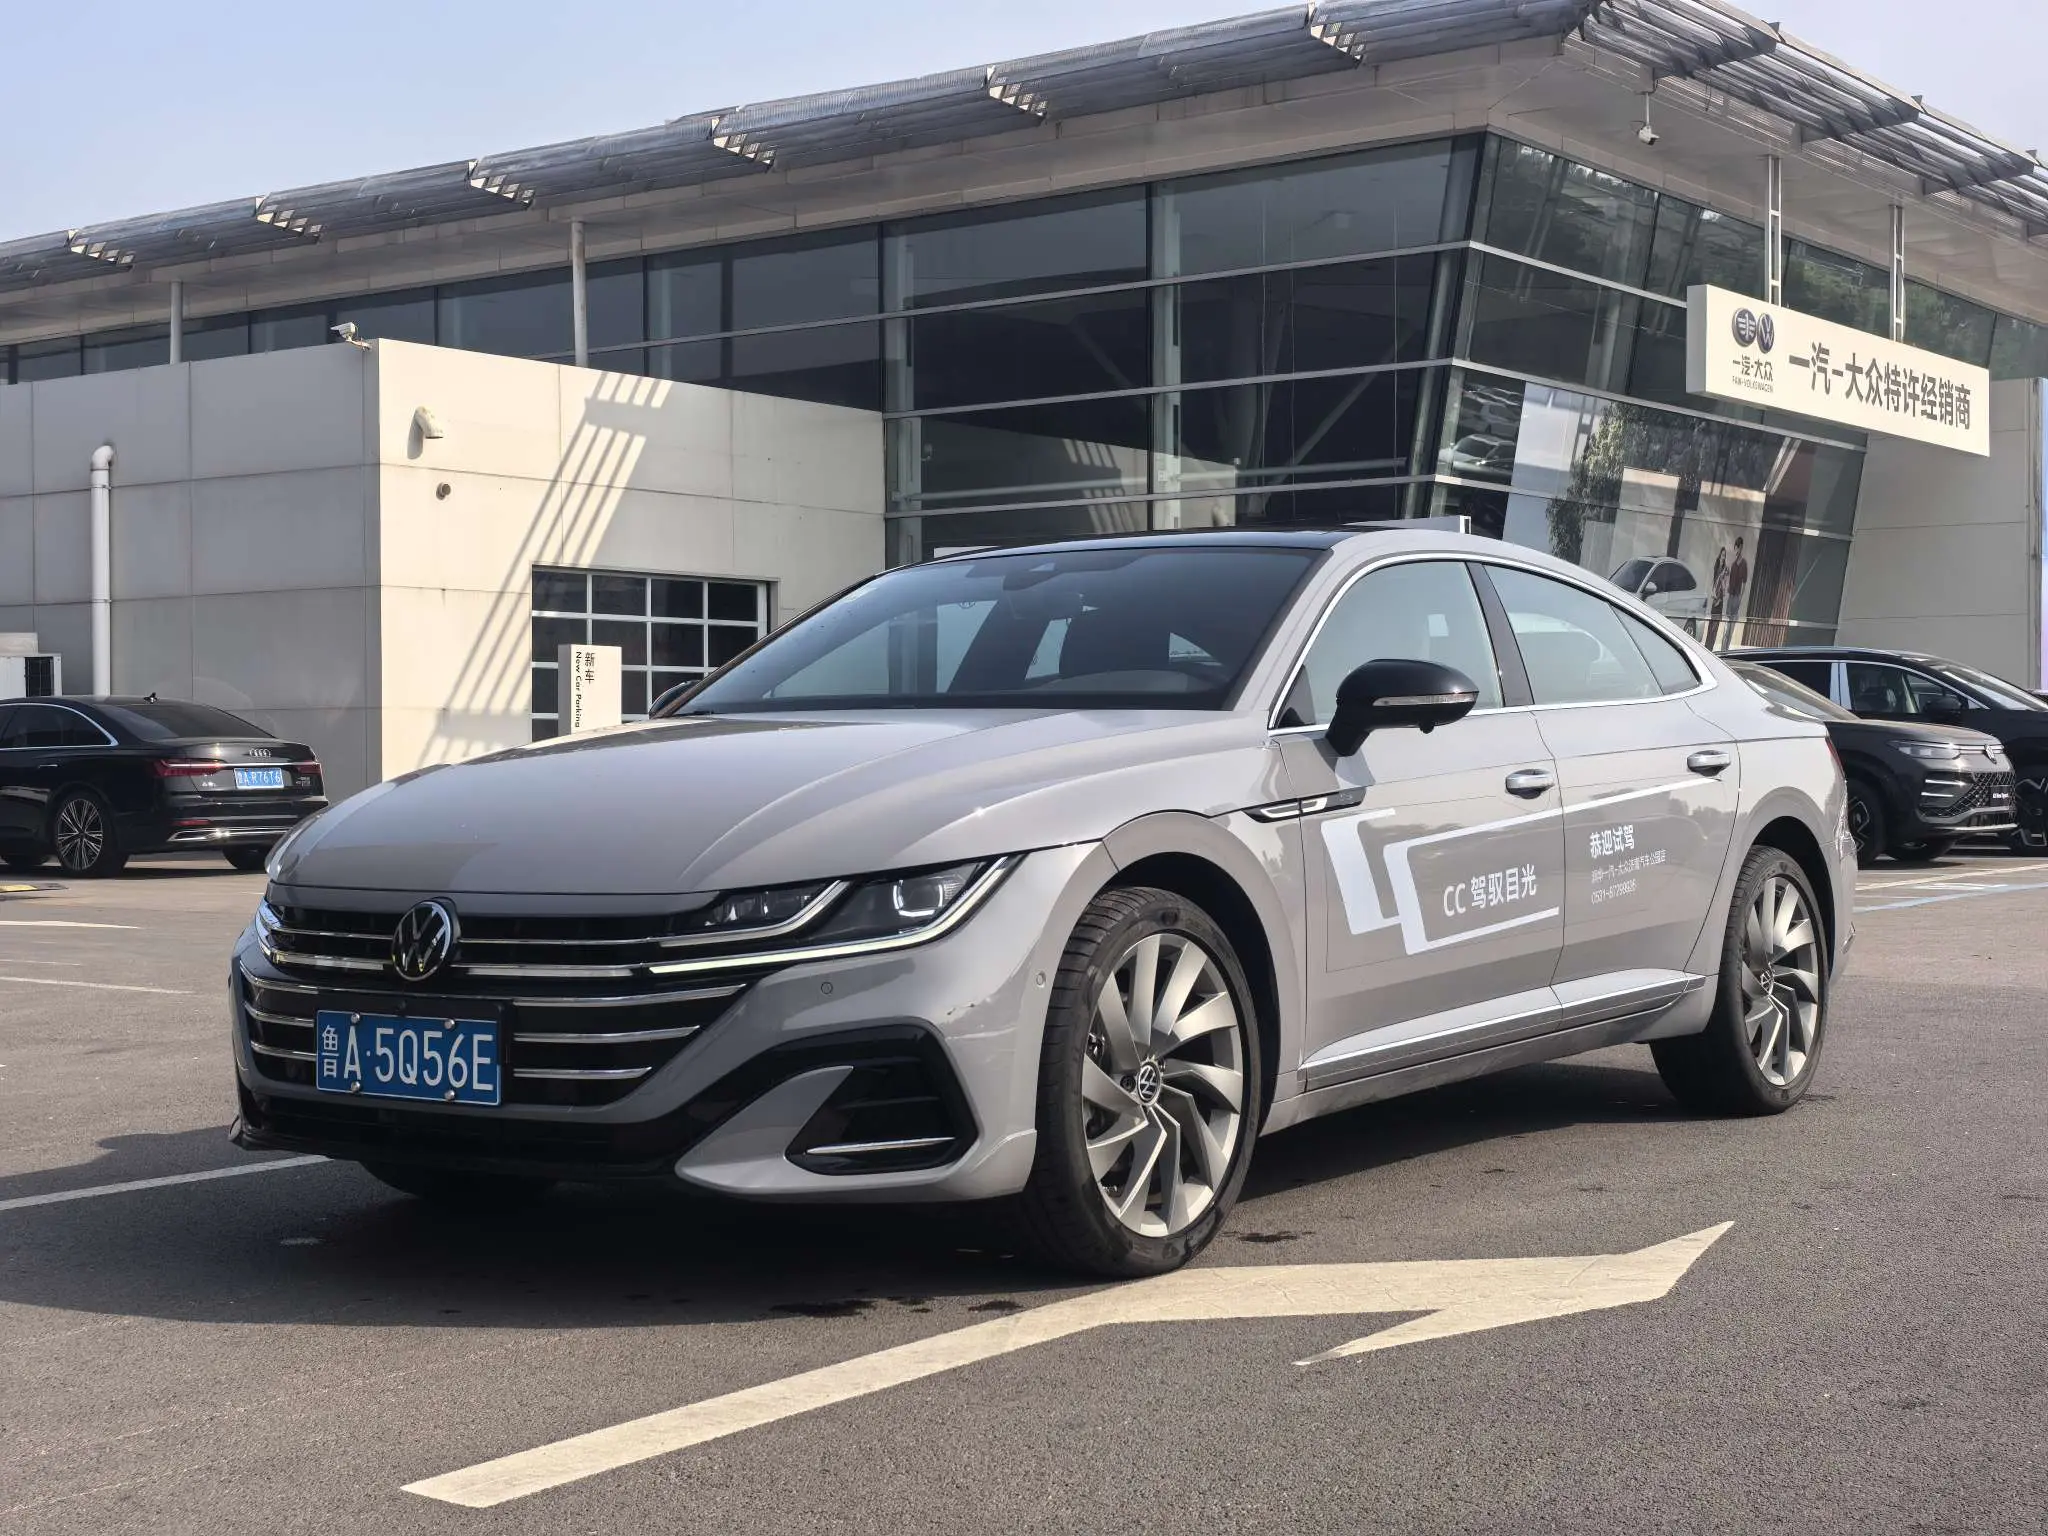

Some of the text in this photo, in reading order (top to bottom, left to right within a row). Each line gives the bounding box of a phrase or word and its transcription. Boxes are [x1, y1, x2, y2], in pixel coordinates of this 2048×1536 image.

[1789, 342, 1971, 430] 一汽-大众特许经销商
[1443, 863, 1537, 917] CC 驾驭目光
